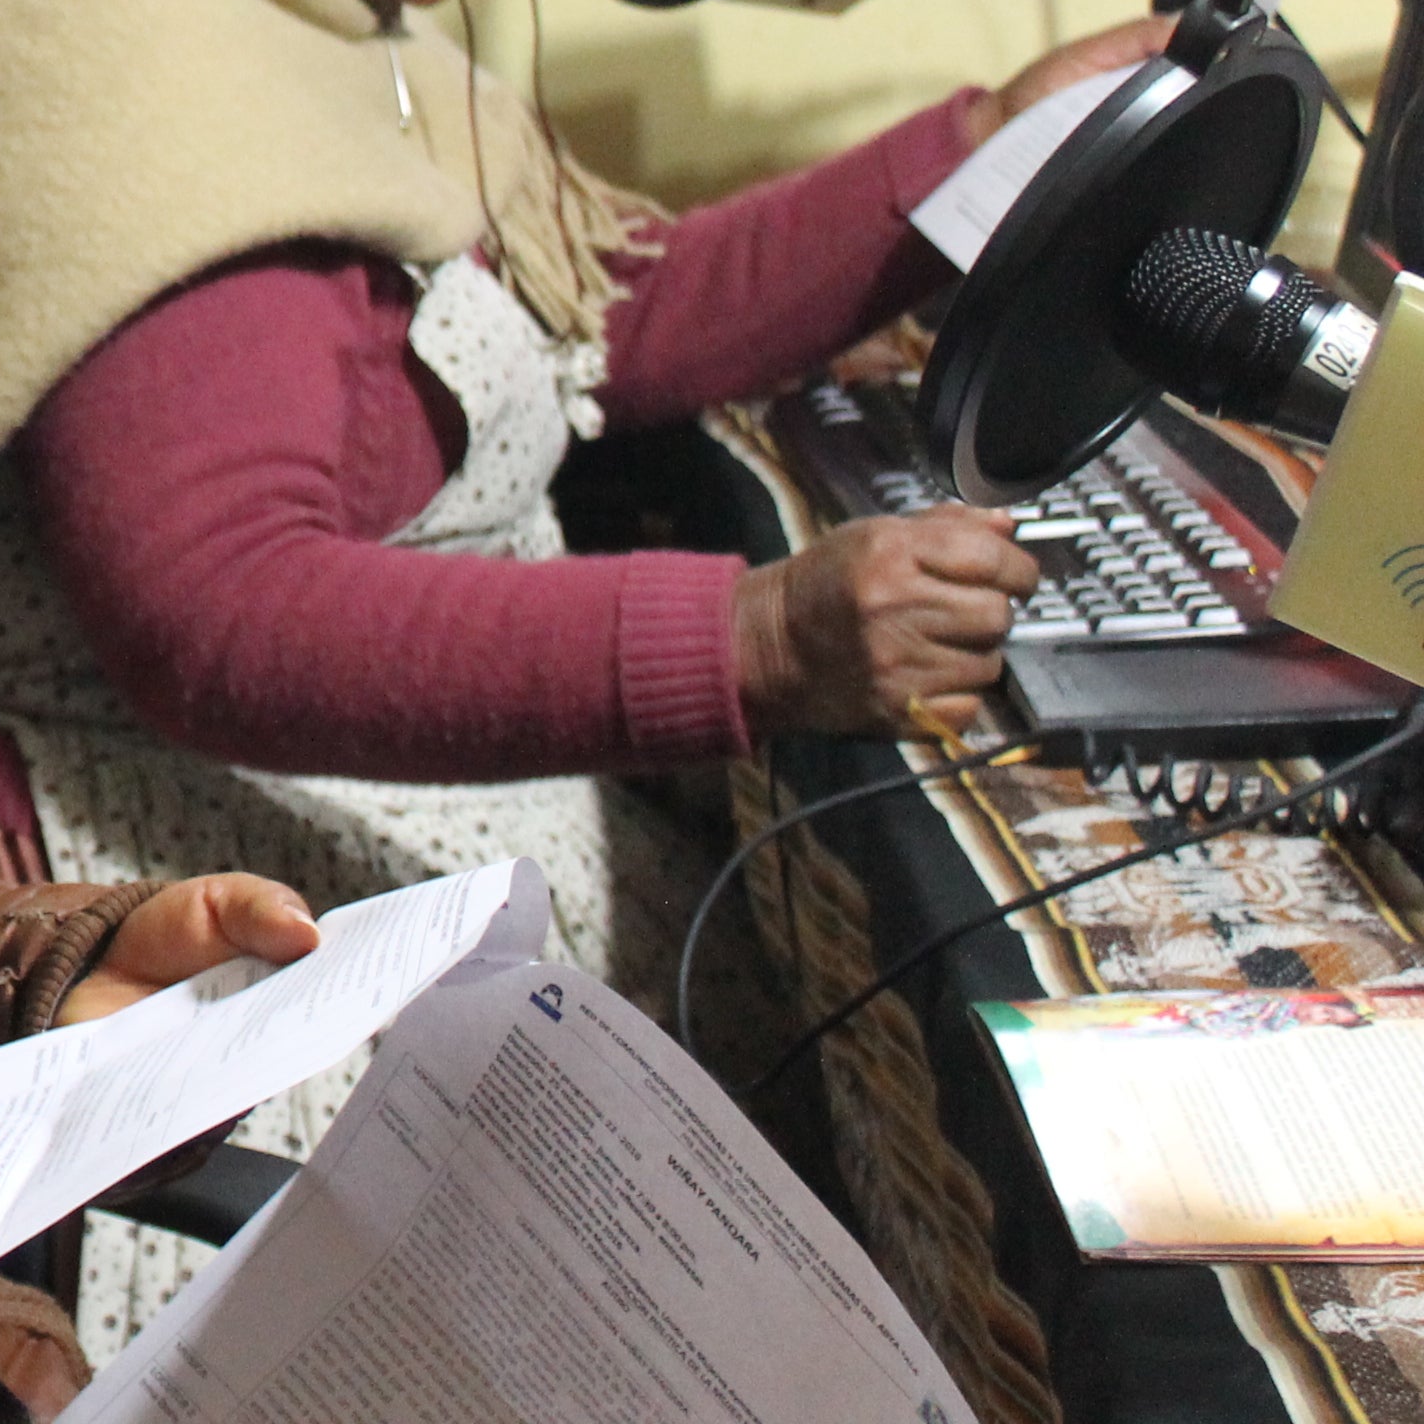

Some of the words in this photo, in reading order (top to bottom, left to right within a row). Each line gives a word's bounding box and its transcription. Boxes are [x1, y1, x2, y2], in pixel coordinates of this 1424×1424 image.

[548, 1059, 563, 1075] de
[558, 1087, 597, 1130] minutos
[474, 1081, 503, 1112] Fecha
[499, 1108, 514, 1124] de
[557, 1174, 604, 1227] noviembre
[530, 1126, 554, 1152] Rosa
[532, 1077, 547, 1092] de
[621, 1176, 638, 1193] de
[596, 1020, 611, 1035] DE
[609, 1029, 684, 1110] COMUNICADORES
[730, 1160, 745, 1174] LA
[769, 1203, 784, 1219] DE
[780, 1216, 822, 1261] MUJERES
[817, 1259, 863, 1307] AYMARAS
[858, 1304, 878, 1324] DEL
[580, 1220, 594, 1235] de
[664, 1152, 708, 1200] WIÑAY
[702, 1197, 764, 1263] PANQARA
[685, 1358, 702, 1376] DE
[698, 1372, 713, 1388] LA
